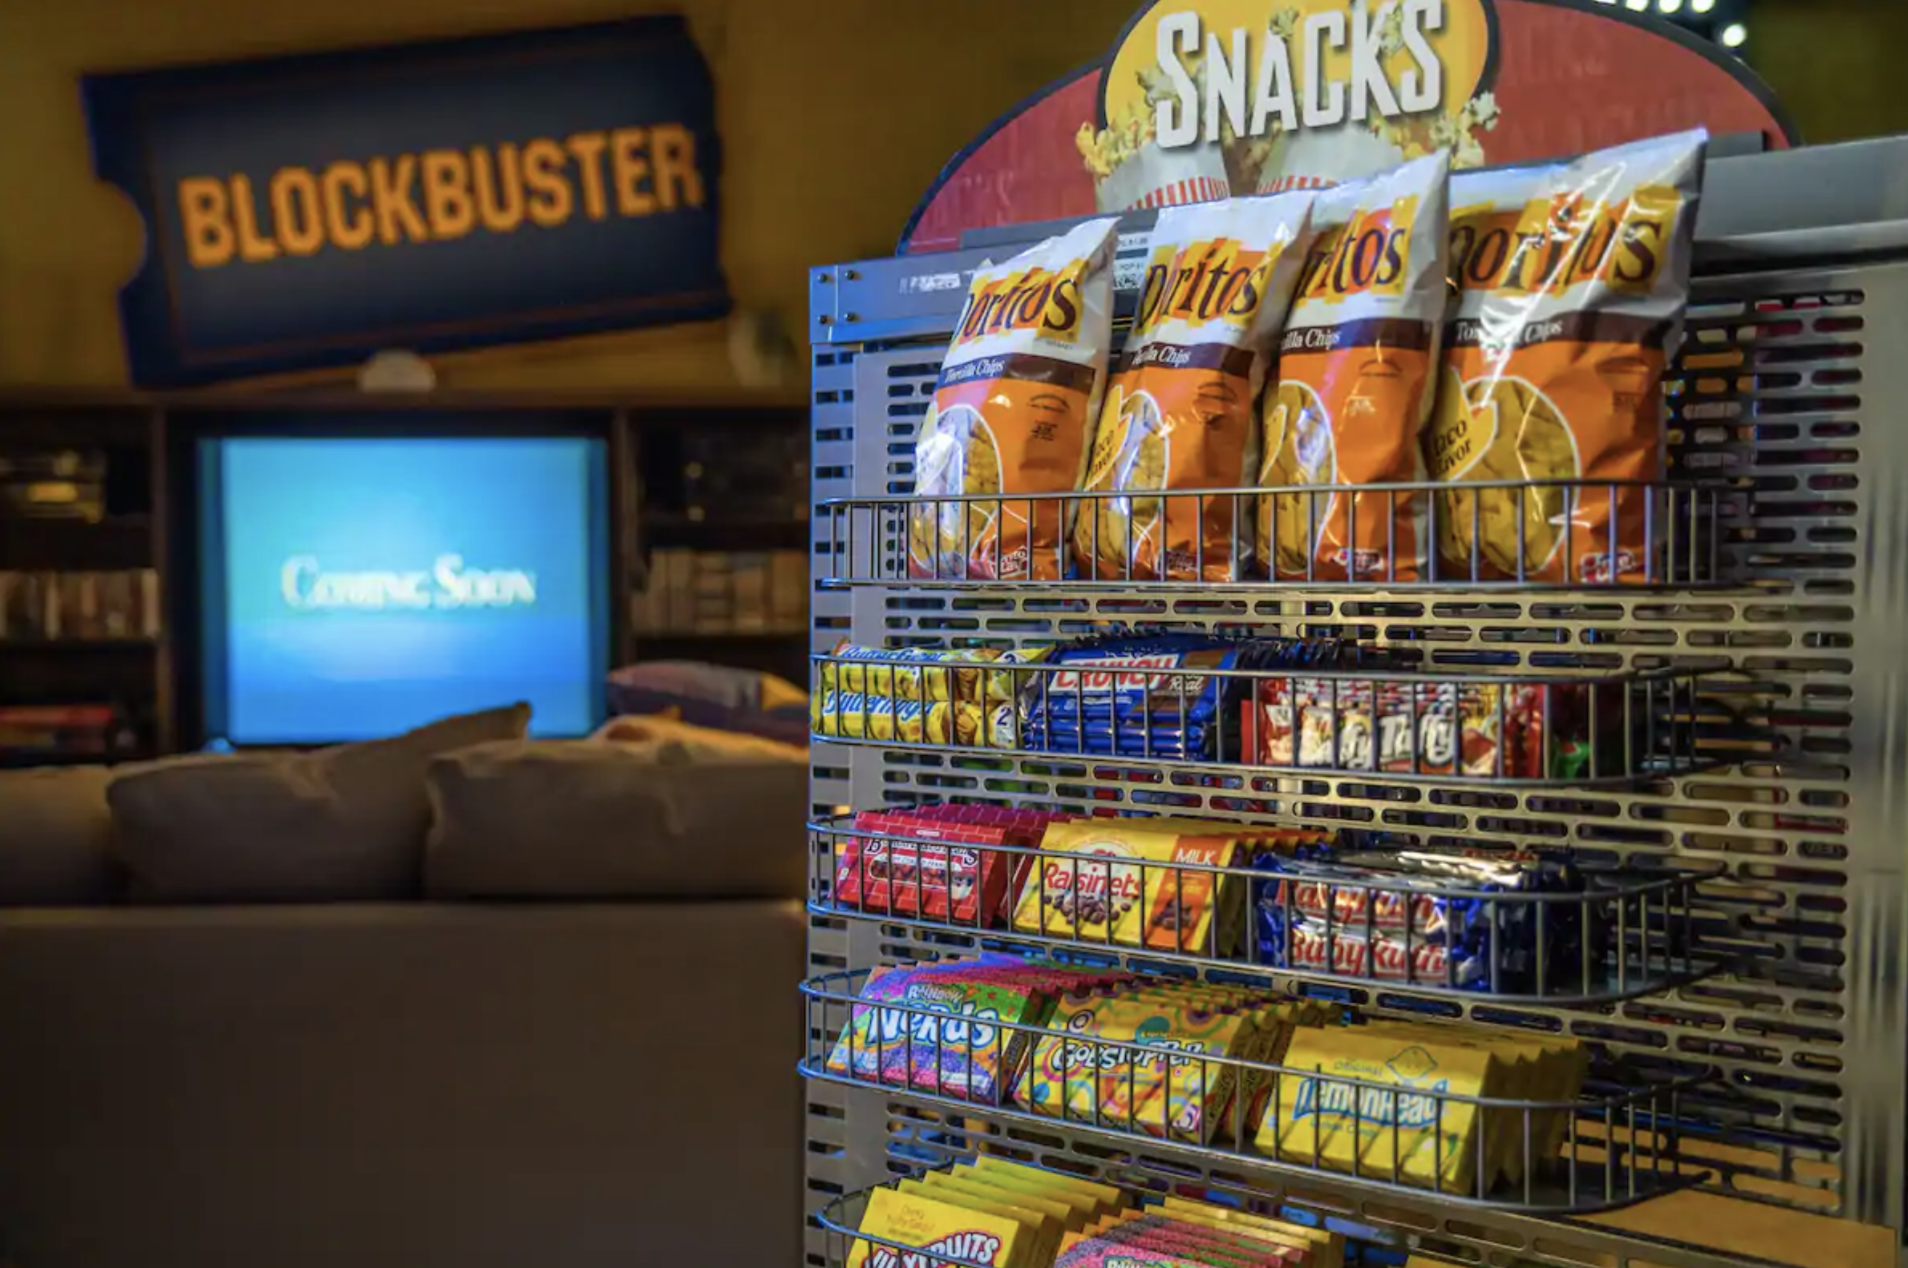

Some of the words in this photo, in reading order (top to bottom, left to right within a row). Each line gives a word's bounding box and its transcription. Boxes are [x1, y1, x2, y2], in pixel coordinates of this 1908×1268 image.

[1156, 0, 1443, 149] SNACKS
[178, 124, 703, 268] BLOCKBUSTER
[1044, 862, 1146, 898] Raisinets
[1175, 847, 1218, 866] MILK
